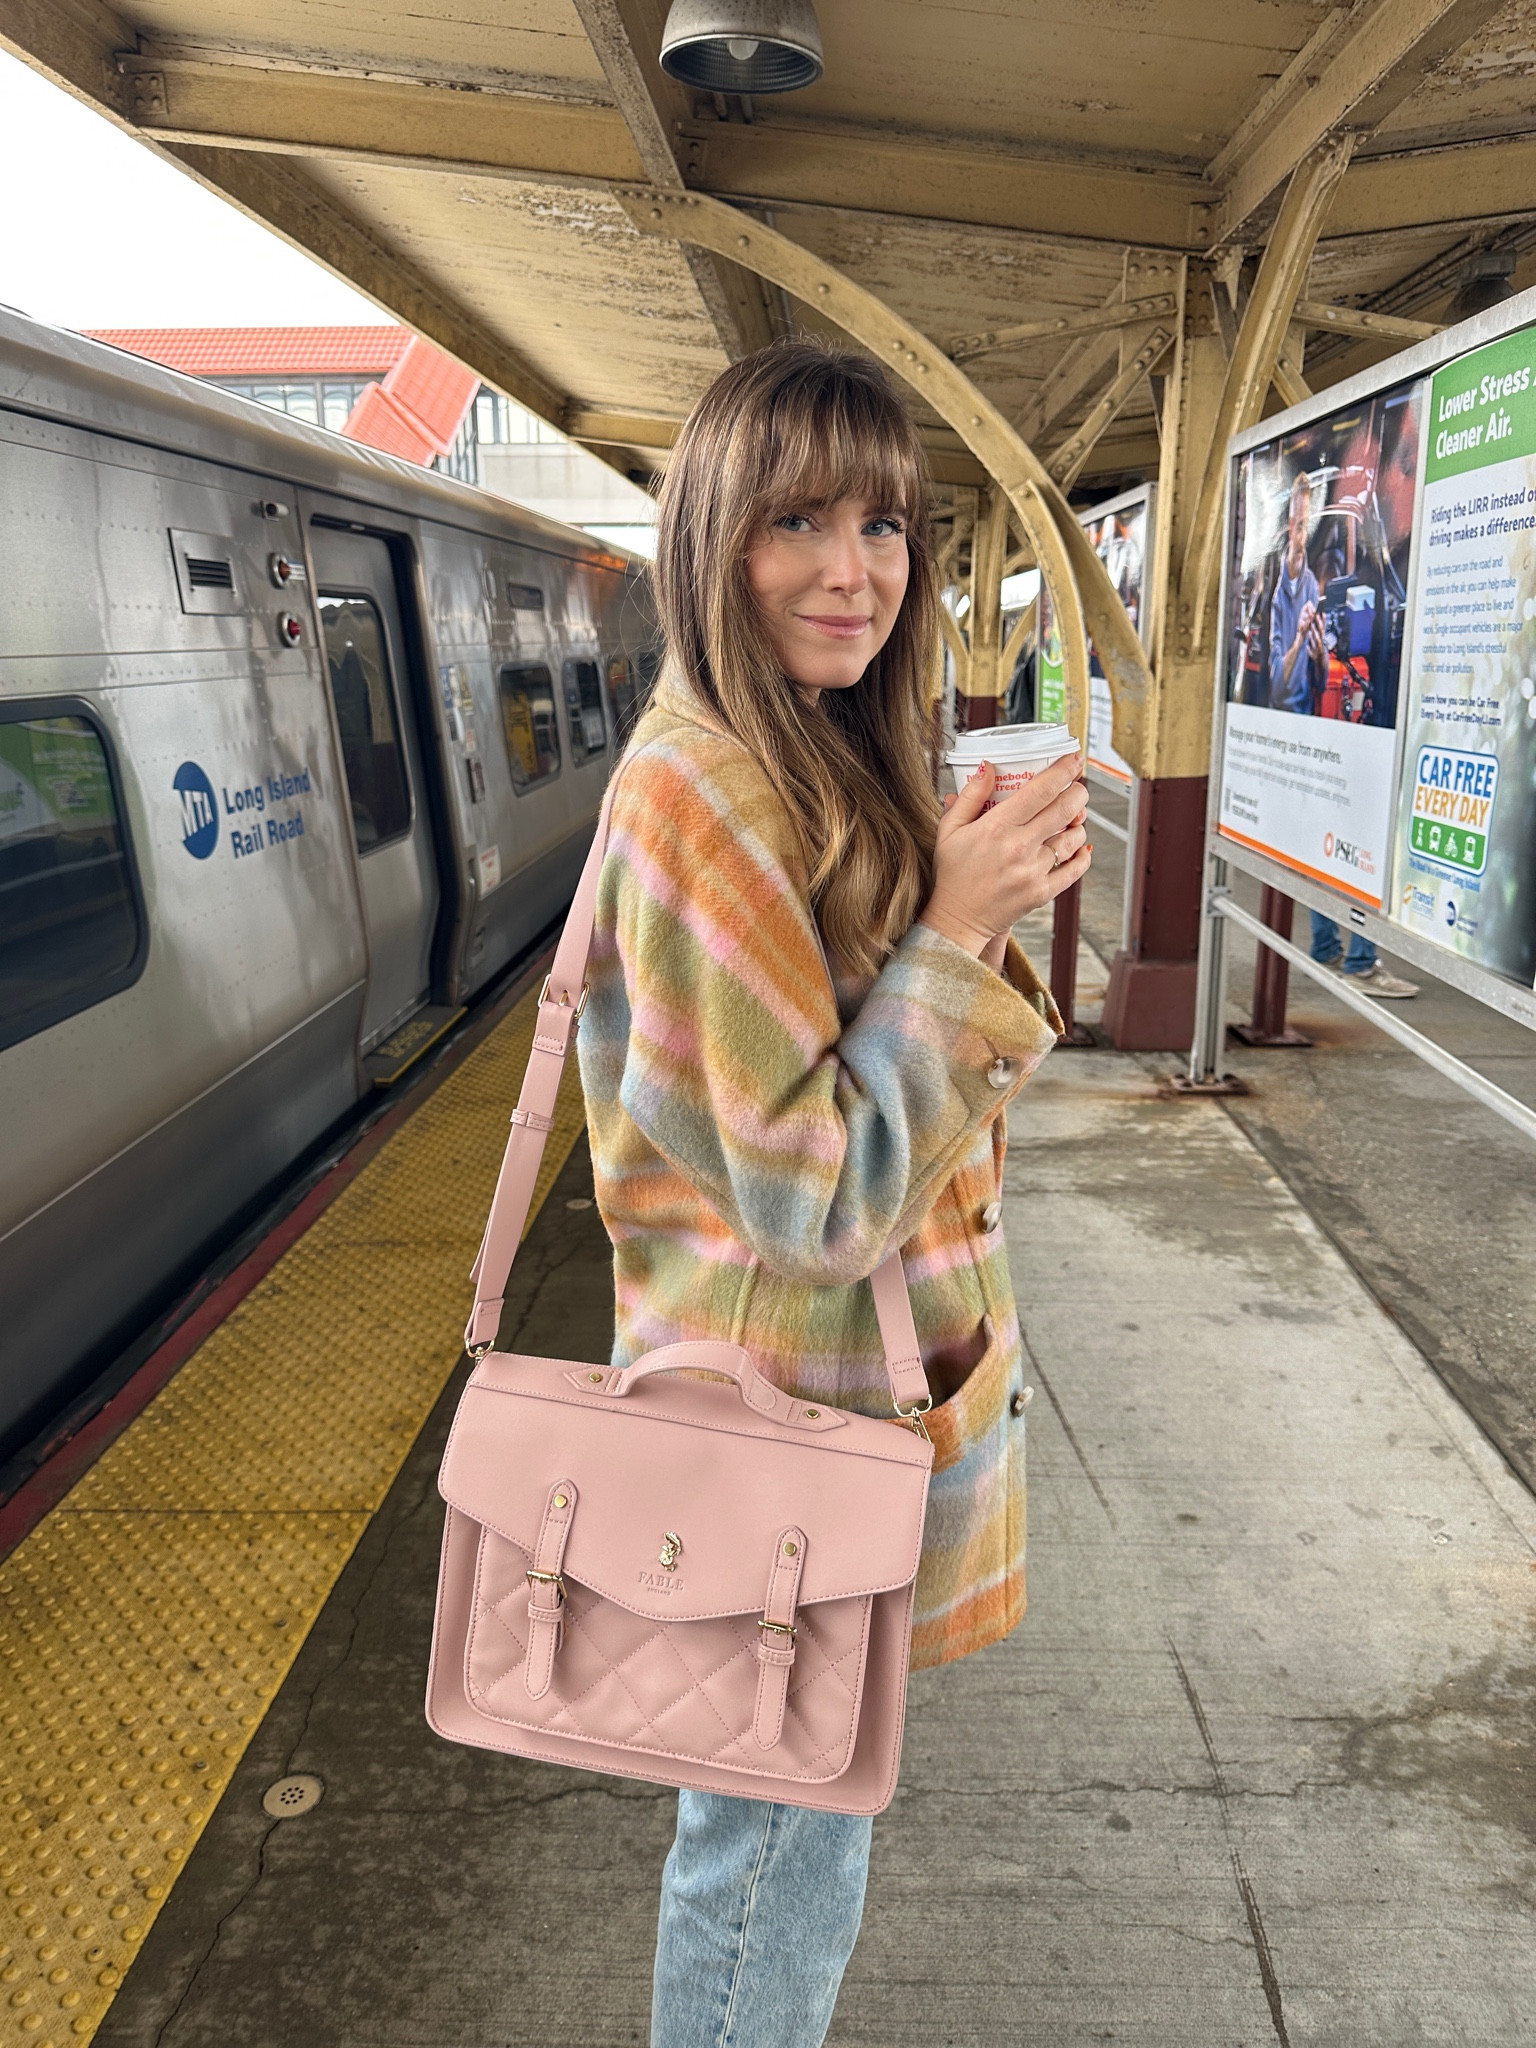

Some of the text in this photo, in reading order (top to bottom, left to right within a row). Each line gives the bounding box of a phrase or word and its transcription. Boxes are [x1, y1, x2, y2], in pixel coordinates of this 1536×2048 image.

[1438, 388, 1478, 423] Lower
[1480, 366, 1531, 406] Stress
[1436, 407, 1513, 460] Cleaner Air.
[1430, 505, 1452, 525] Riding
[1453, 502, 1467, 518] the
[1468, 496, 1489, 515] LIRR
[1490, 486, 1526, 511] instead
[1429, 528, 1452, 548] driving
[1452, 524, 1478, 542] makes
[1480, 525, 1485, 537] a
[1420, 708, 1434, 721] Every
[1435, 709, 1445, 722] Day
[1421, 694, 1500, 710] Learn how you can be Car Free
[222, 767, 312, 815] Long Island
[995, 782, 1022, 792] free?
[1420, 754, 1496, 798] CAR FREE
[180, 790, 214, 838] MTA
[1415, 786, 1490, 828] EVERY DAY
[230, 809, 305, 860] Rail Road
[1413, 886, 1436, 906] Transit
[638, 1571, 685, 1592] FABLE
